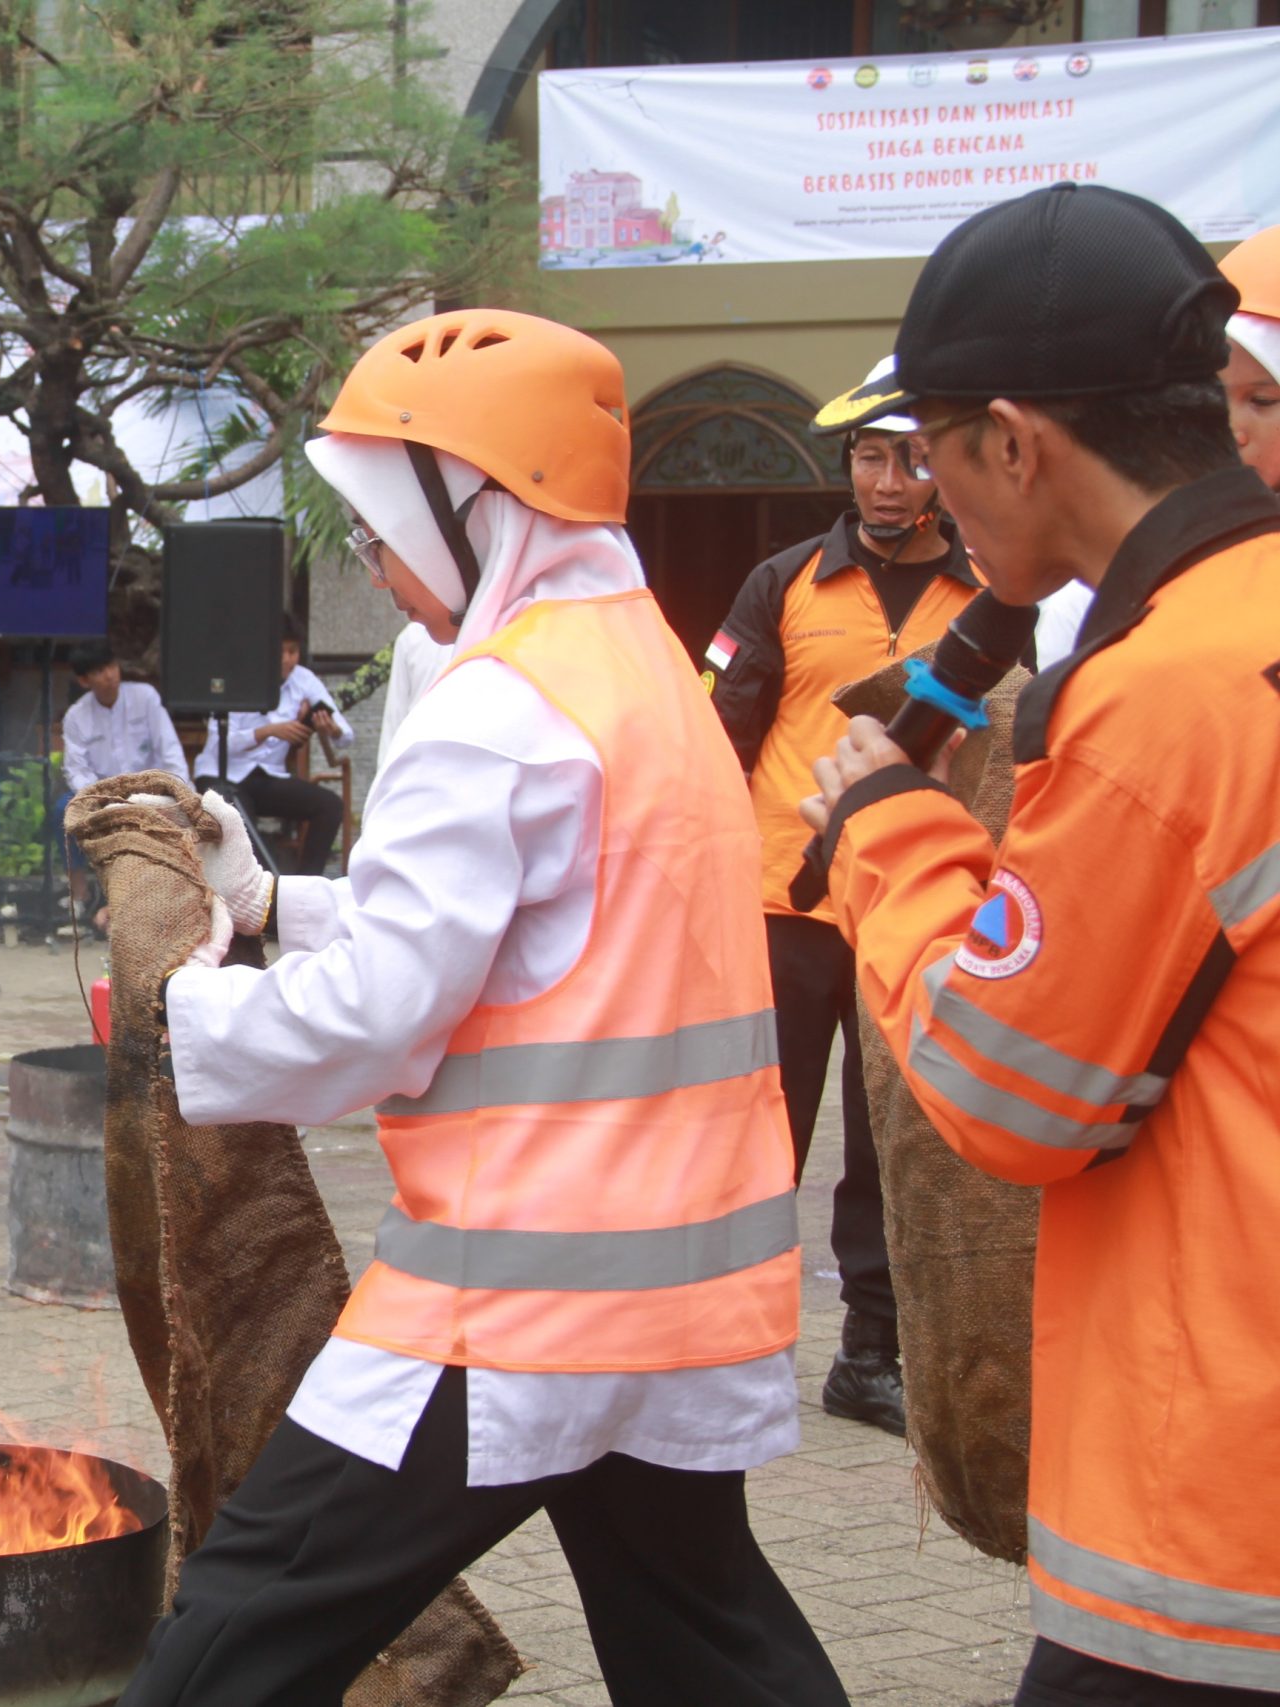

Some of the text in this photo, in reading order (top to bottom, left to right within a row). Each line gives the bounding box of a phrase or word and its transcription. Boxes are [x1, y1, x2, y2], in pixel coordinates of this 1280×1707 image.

[816, 98, 1075, 131] SOSIALISASI DAN SIMULASI
[867, 133, 1025, 161] SIAGA BENCANA
[803, 162, 1099, 194] BERBASIS PONDOK PESANTREN
